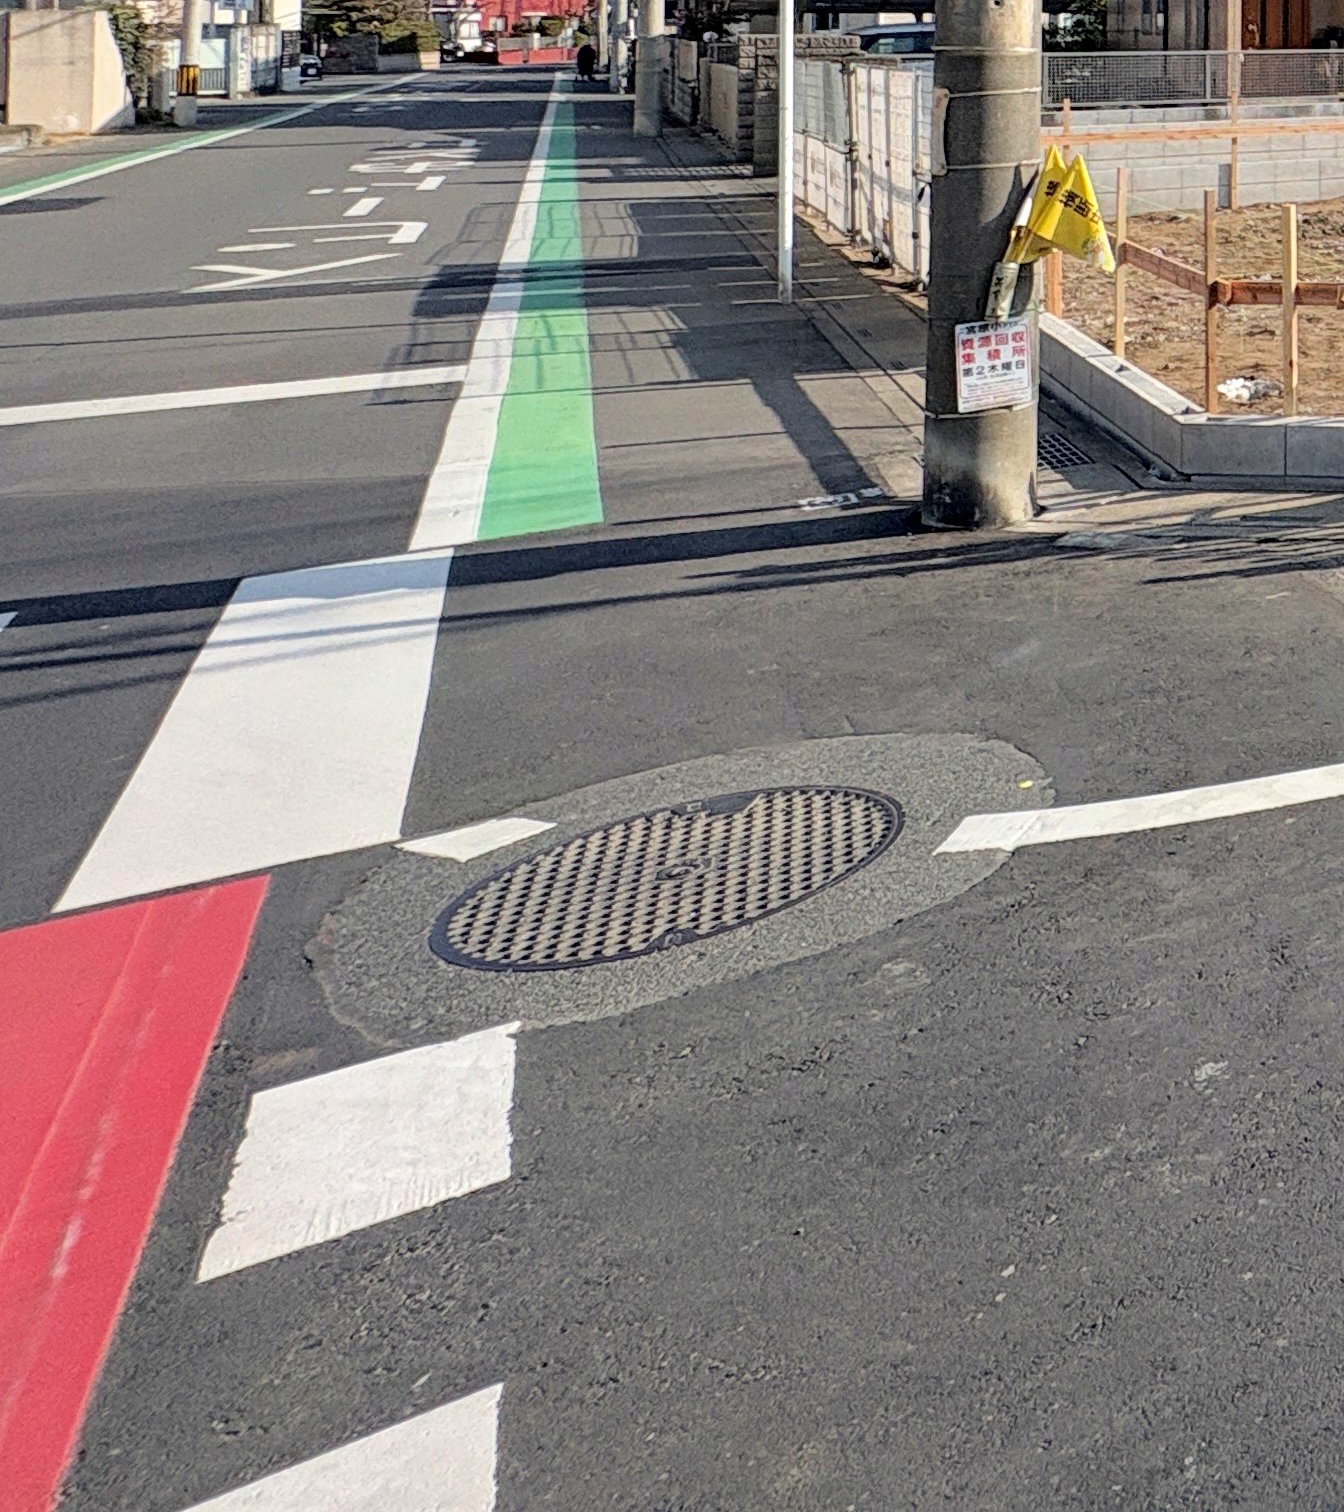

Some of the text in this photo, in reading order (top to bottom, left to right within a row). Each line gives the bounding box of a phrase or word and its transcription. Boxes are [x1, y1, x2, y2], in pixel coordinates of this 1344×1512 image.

[962, 331, 1025, 350] 資源回収
[961, 345, 1025, 365] 集積所
[962, 360, 1025, 377] 第2木曜日
